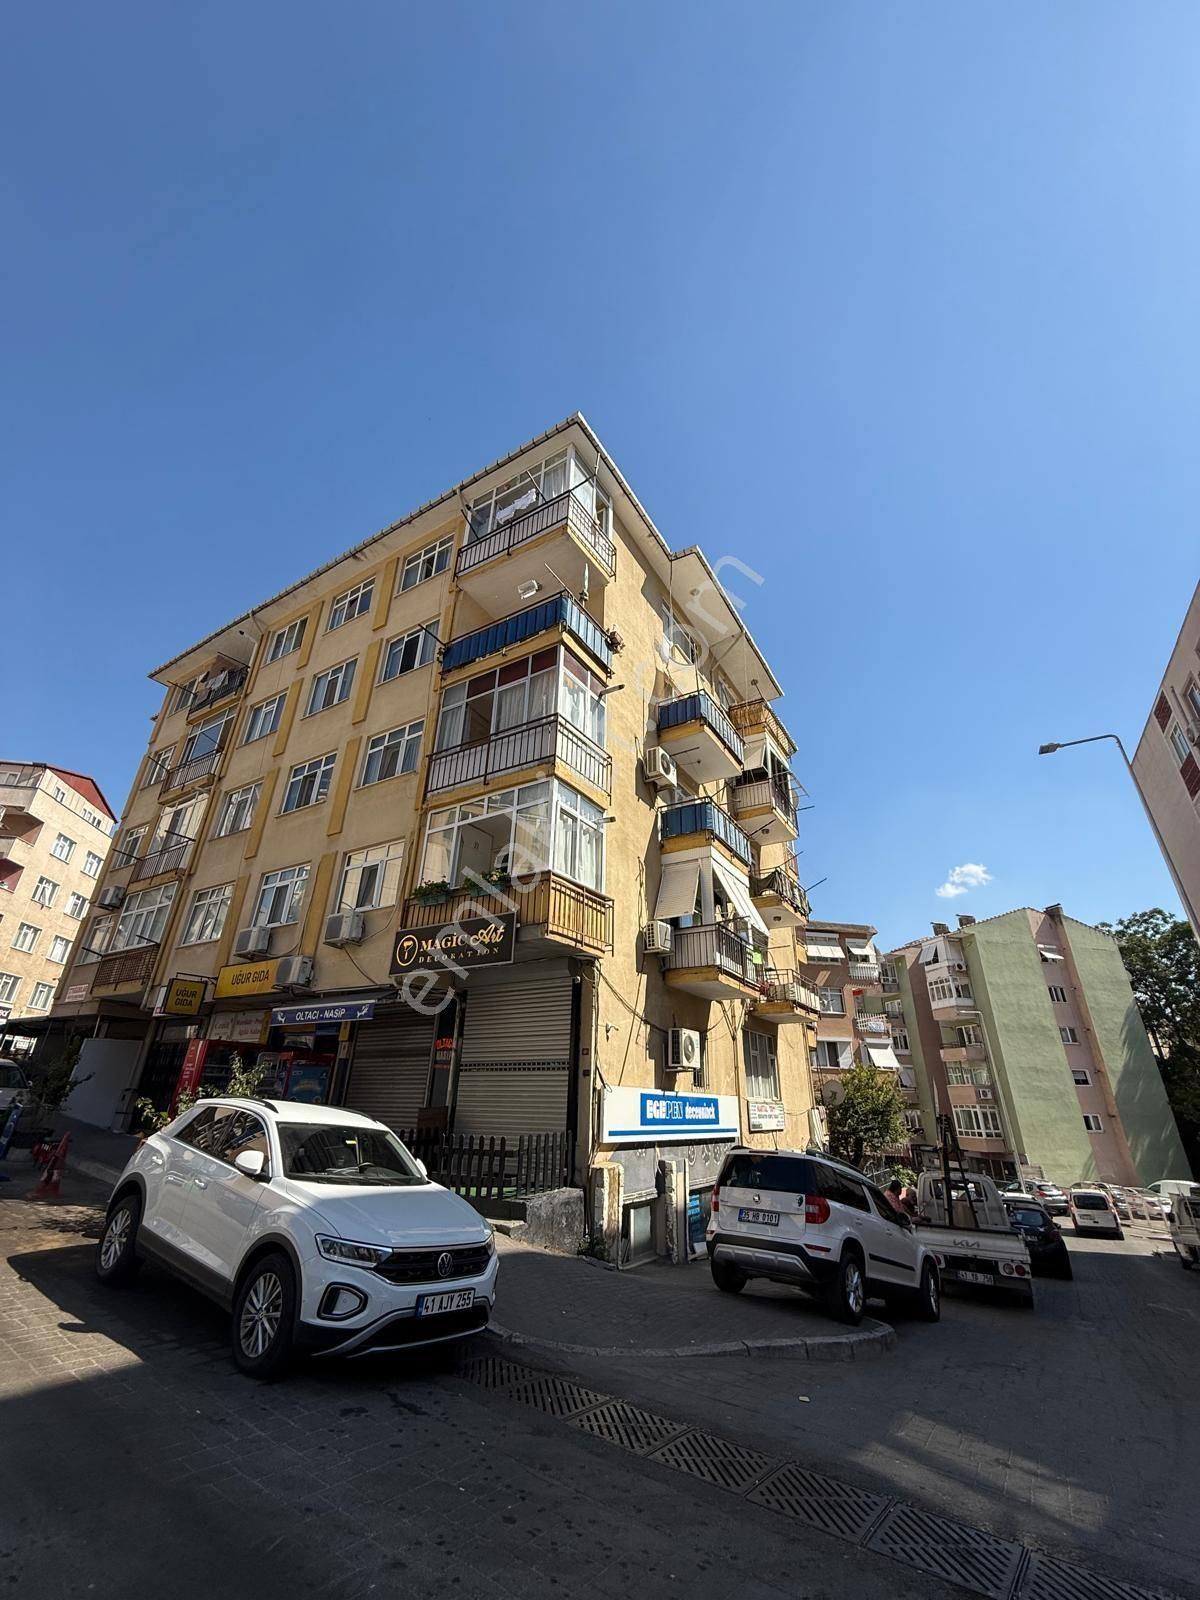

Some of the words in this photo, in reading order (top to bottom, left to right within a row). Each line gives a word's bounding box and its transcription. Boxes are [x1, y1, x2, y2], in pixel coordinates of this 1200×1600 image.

[470, 923, 505, 945] Art
[231, 970, 251, 985] UĞUR
[251, 969, 269, 982] GIDA
[176, 987, 197, 999] UĞUR
[175, 998, 193, 1007] GIDA
[295, 1010, 319, 1021] OLTACI
[324, 1008, 345, 1018] NASİP
[424, 1297, 435, 1313] 41
[438, 1294, 454, 1313] AJY
[456, 1292, 472, 1308] 255
